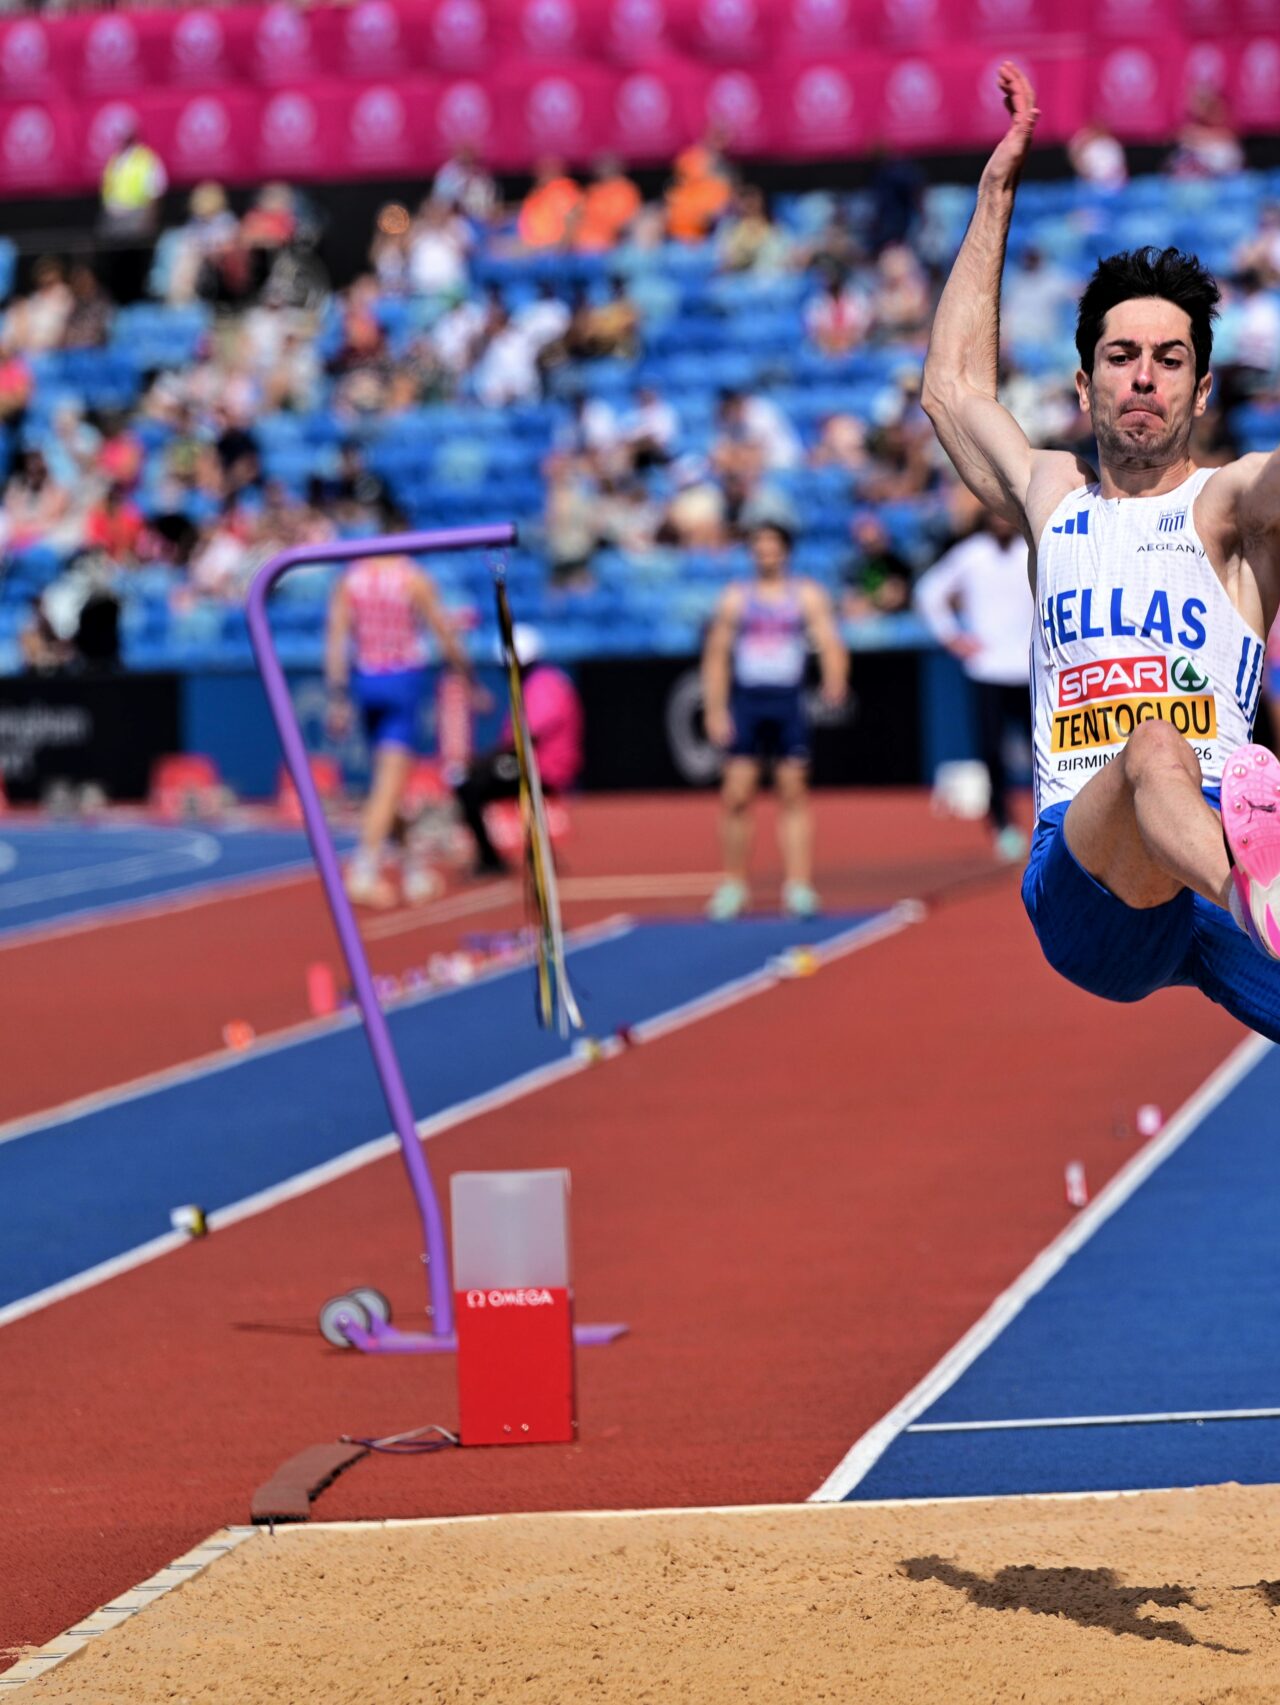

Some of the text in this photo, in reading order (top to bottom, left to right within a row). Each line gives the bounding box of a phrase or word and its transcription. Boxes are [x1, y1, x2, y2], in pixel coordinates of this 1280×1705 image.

[1136, 543, 1195, 554] AEGEAN
[1041, 588, 1207, 650] HELLAS
[1061, 661, 1164, 701] SPAR
[1057, 746, 1212, 771] BIRMIN 26
[488, 1288, 555, 1307] OMEGA
